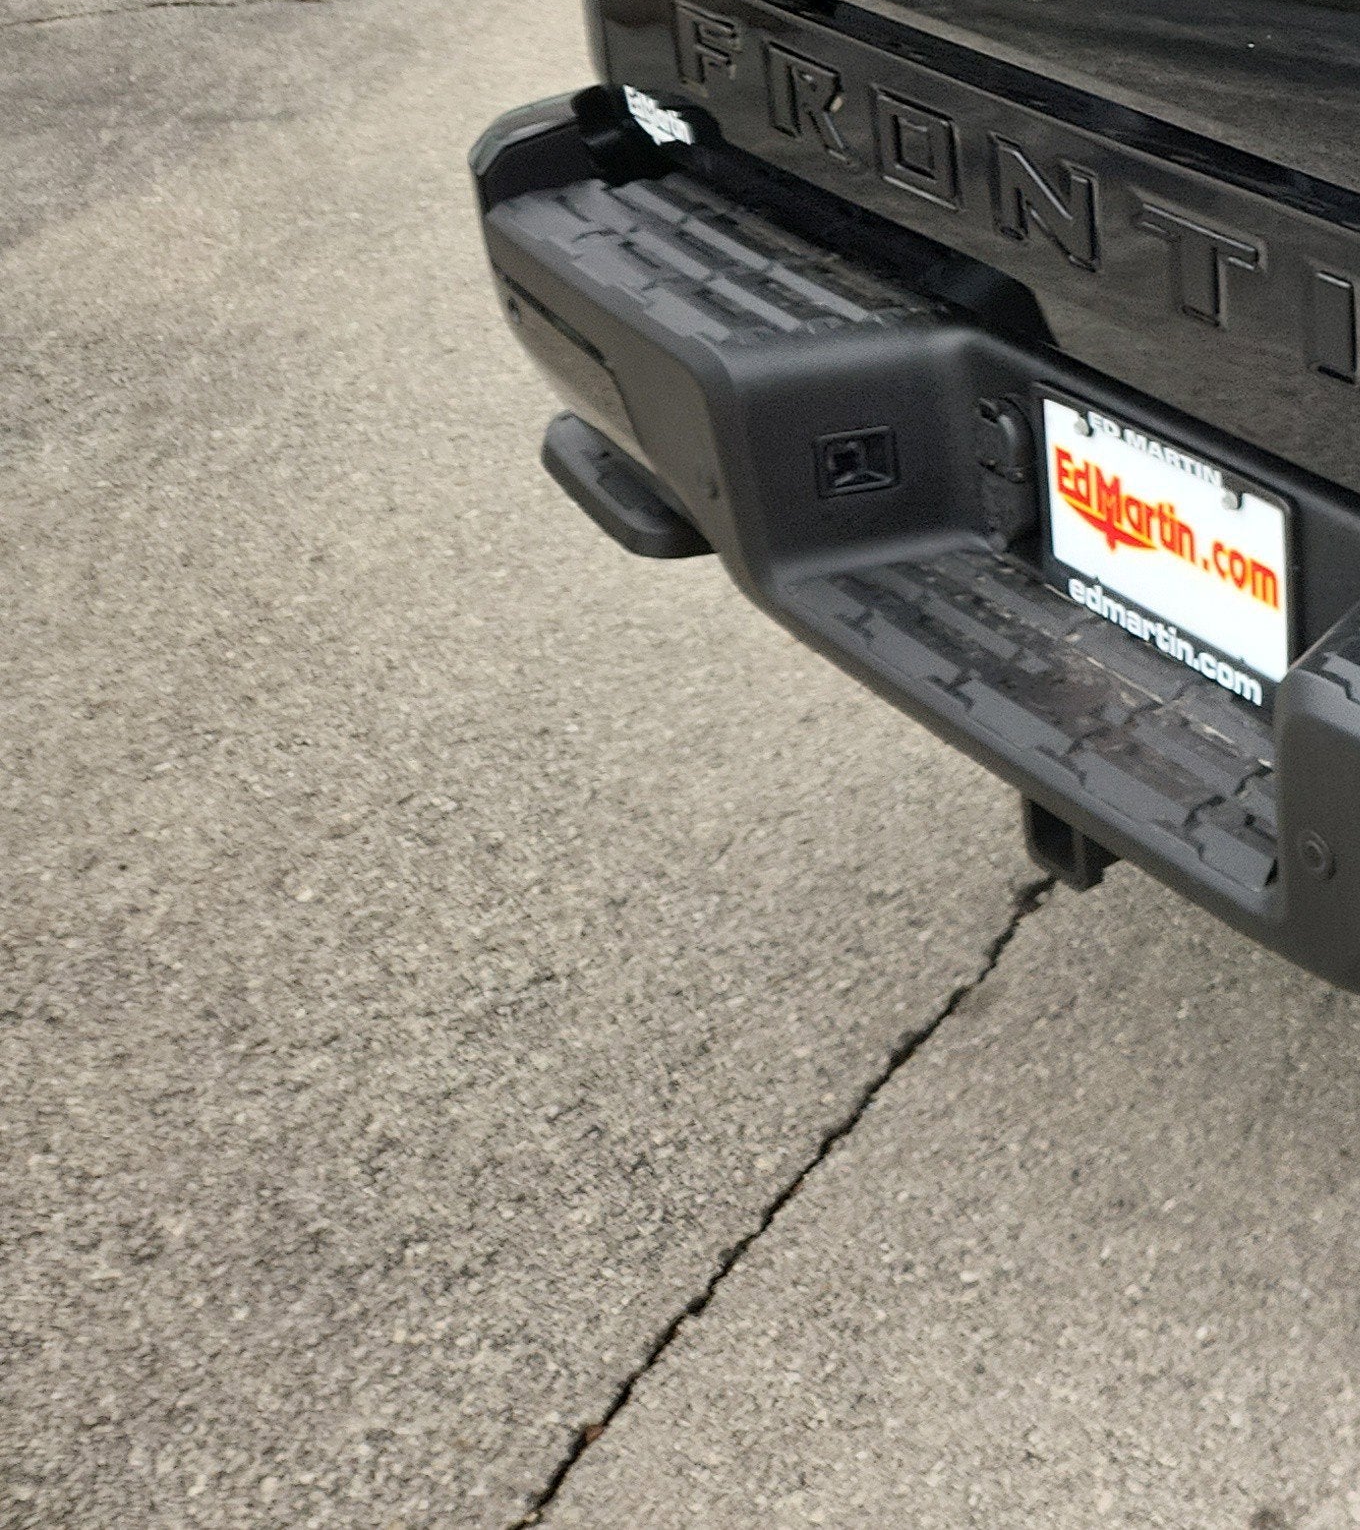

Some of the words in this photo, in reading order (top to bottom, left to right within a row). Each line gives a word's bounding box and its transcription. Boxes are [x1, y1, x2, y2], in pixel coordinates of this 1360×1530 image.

[1087, 410, 1122, 439] ED
[1124, 427, 1223, 491] MARTIN
[1068, 577, 1262, 706] edmartin.com
